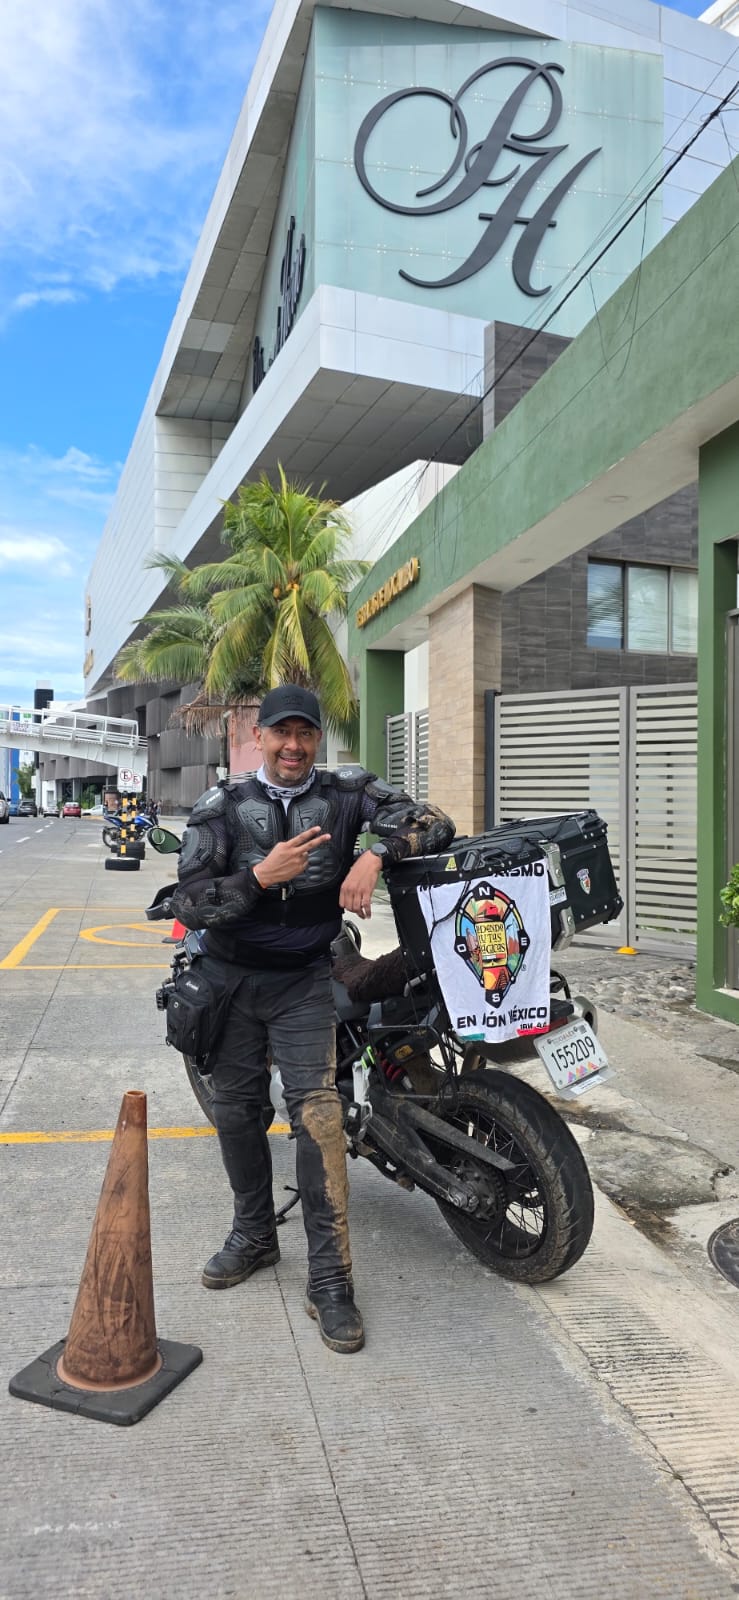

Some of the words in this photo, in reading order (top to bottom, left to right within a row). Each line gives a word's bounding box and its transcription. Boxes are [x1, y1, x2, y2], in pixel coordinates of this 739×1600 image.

[479, 887, 491, 896] N
[492, 993, 500, 1003] S
[457, 1015, 477, 1029] EN
